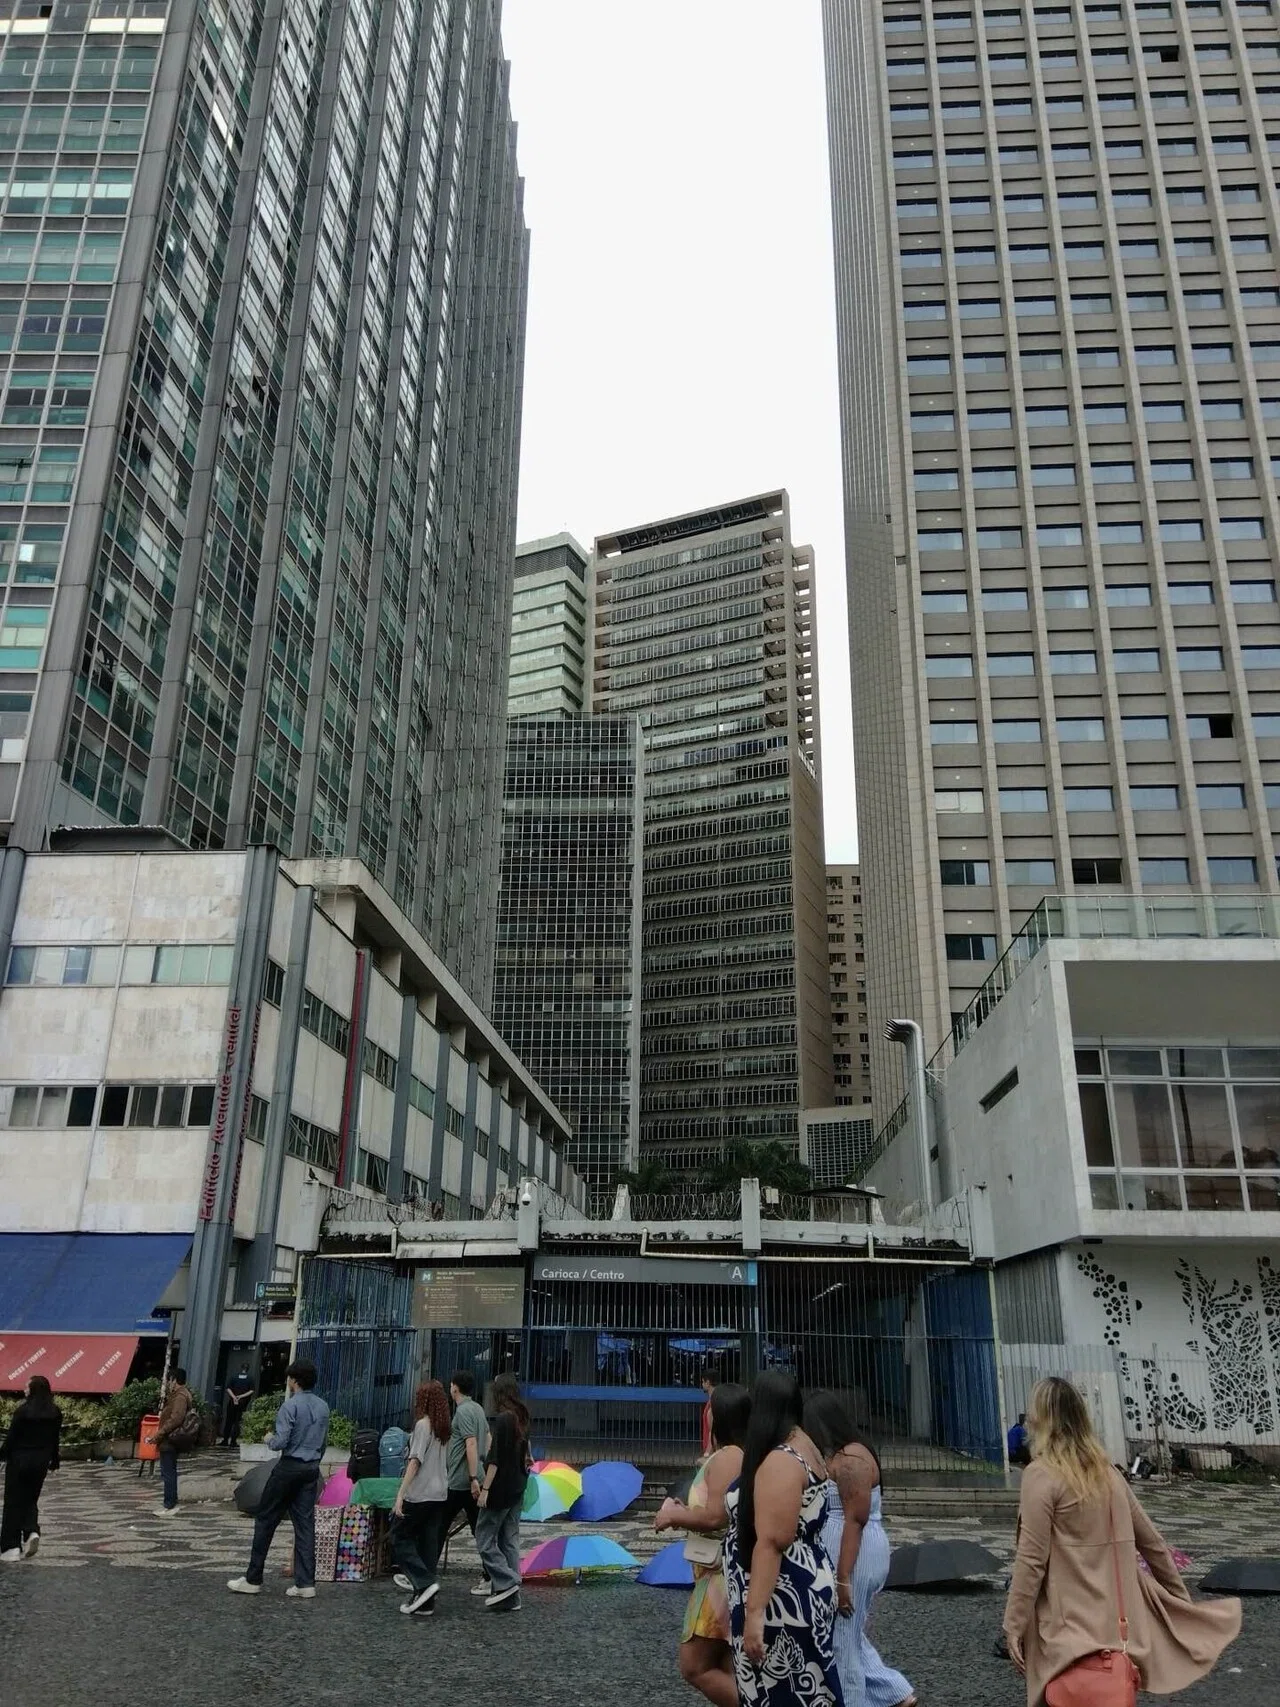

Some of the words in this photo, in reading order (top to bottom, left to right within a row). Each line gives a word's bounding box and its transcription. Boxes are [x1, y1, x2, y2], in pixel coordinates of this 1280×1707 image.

[211, 1073, 232, 1145] Avenida
[541, 1268, 580, 1279] Carioca
[582, 1269, 588, 1280] /
[590, 1269, 625, 1280] Centro
[731, 1265, 743, 1280] A
[54, 1349, 85, 1378] CONFEITARIA
